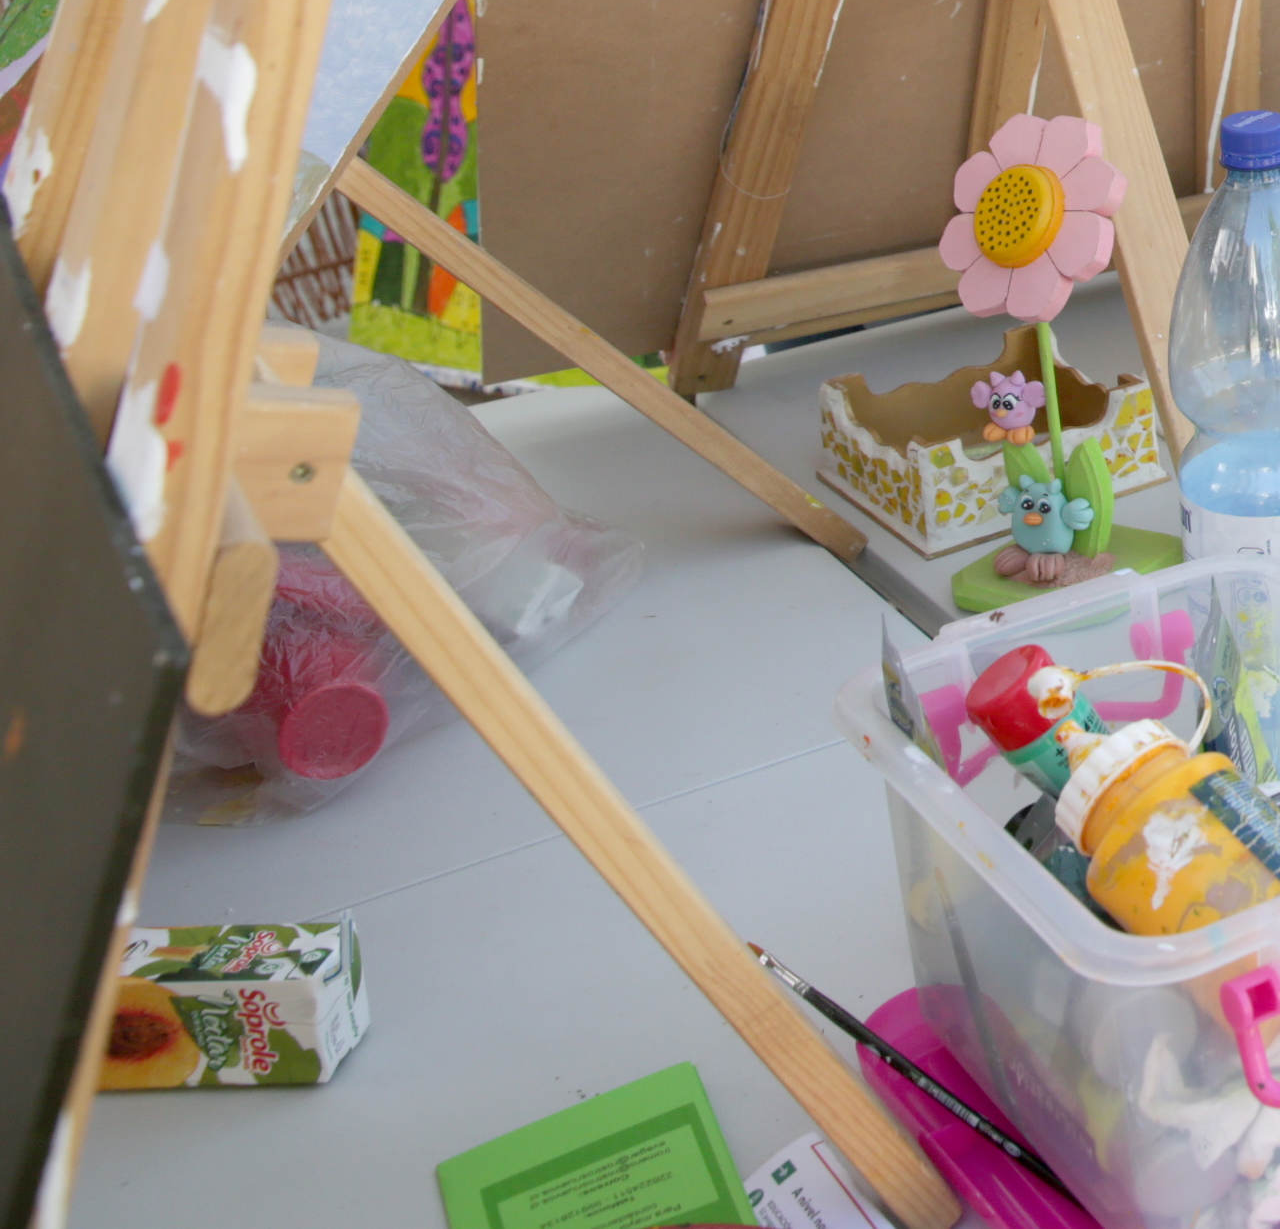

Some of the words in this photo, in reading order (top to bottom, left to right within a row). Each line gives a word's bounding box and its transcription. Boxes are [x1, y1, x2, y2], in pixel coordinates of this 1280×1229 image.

[237, 988, 278, 1073] Soprole
[791, 1186, 804, 1199] A
[798, 1196, 821, 1221] nivel
